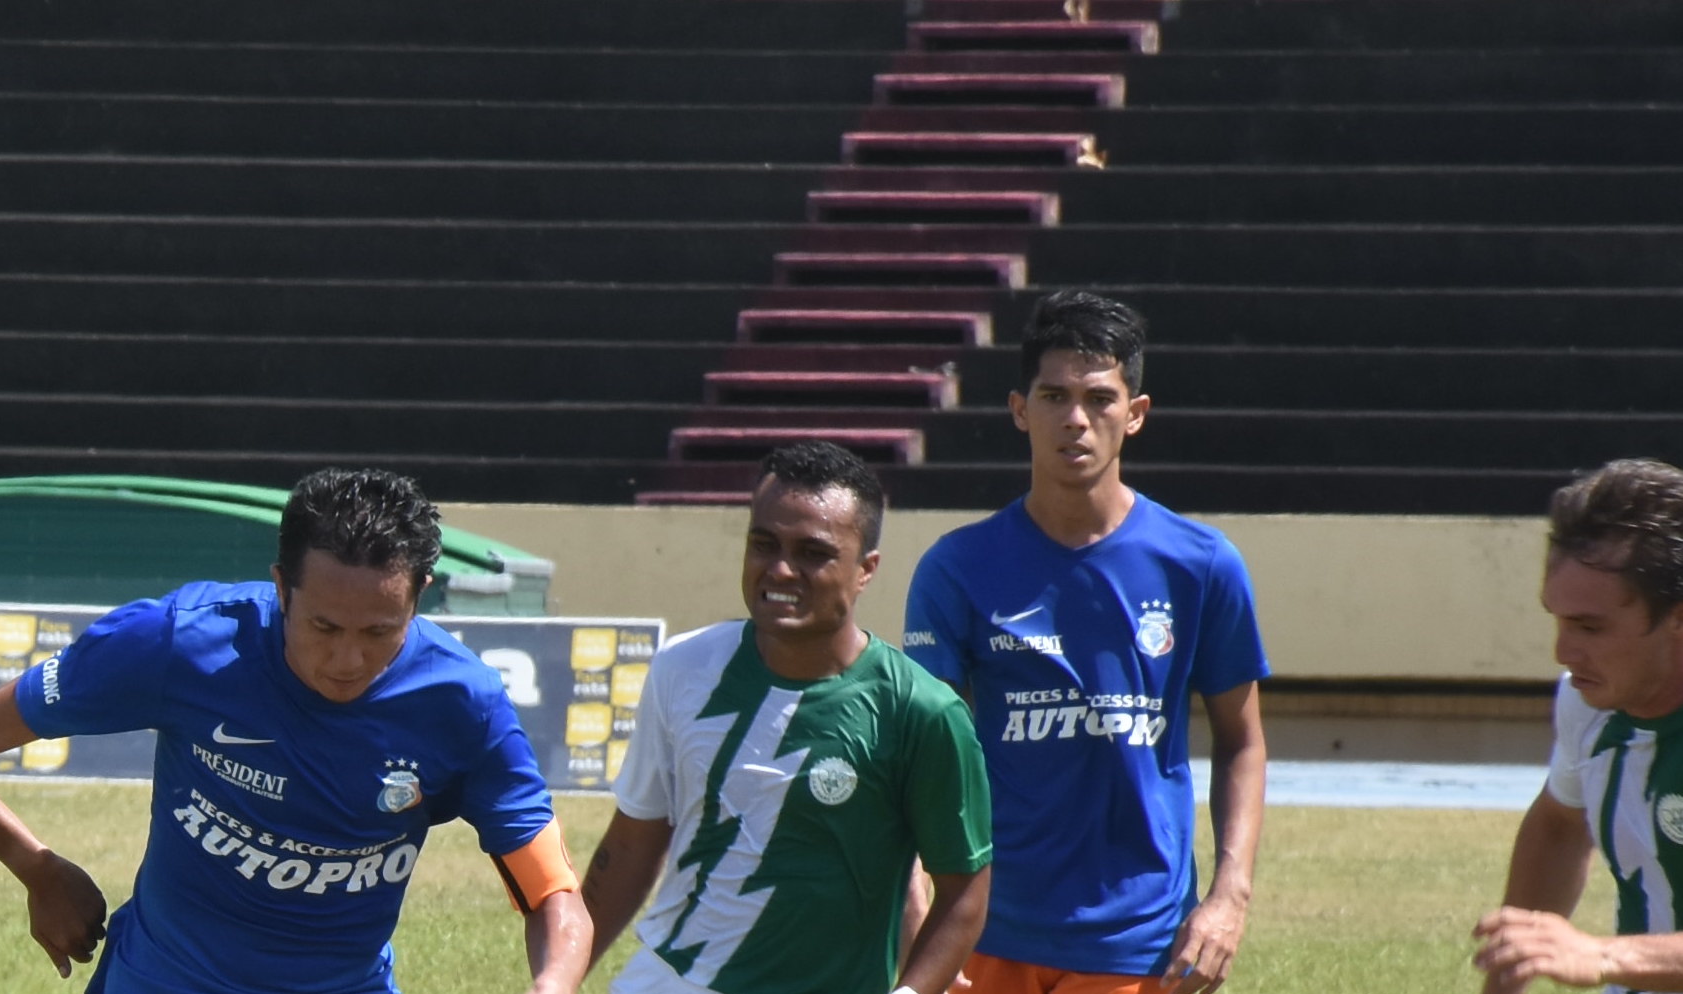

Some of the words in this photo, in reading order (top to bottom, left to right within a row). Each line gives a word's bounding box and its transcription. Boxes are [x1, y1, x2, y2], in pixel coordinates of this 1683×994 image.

[618, 643, 654, 657] rata
[573, 682, 609, 697] rata
[1004, 688, 1063, 705] PIECES
[1067, 687, 1081, 700] &
[614, 718, 636, 732] rat
[192, 743, 288, 795] PRÉSIDENT
[568, 758, 604, 772] rata
[190, 788, 253, 839] PIECES
[258, 832, 274, 847] &
[173, 803, 417, 894] AUTOPRO
